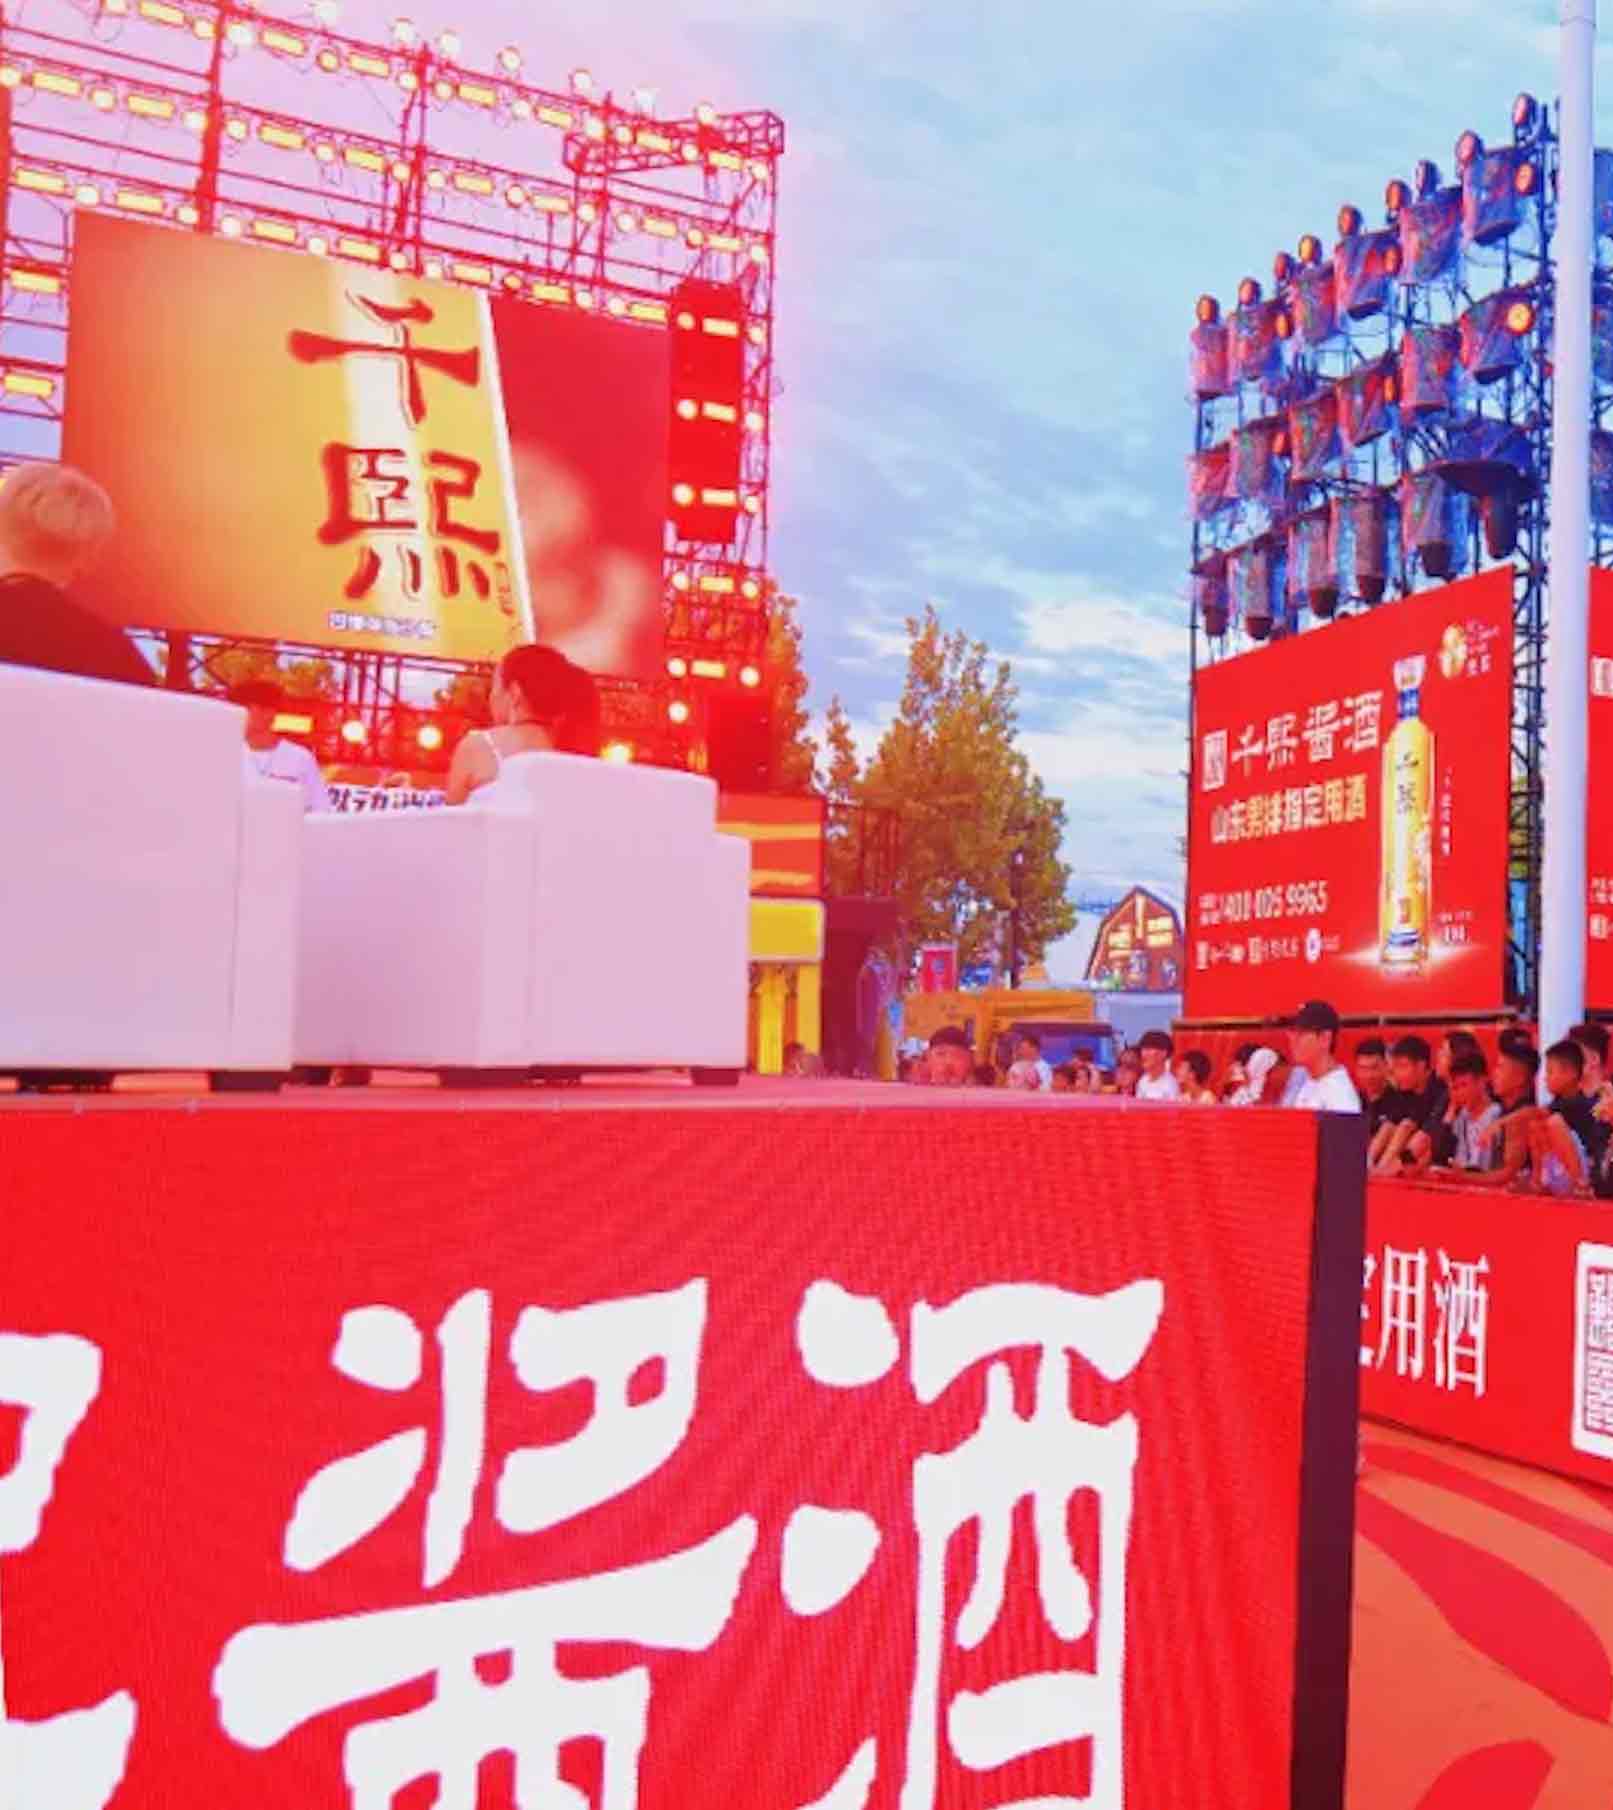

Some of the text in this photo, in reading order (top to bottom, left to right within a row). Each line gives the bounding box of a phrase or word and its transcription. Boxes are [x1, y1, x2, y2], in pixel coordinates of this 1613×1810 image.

[286, 289, 500, 600] 千熙
[1211, 774, 1367, 845] 山东男排指定用酒
[1230, 690, 1383, 776] 千熙酱酒
[0, 1277, 1165, 1810] 酱酒
